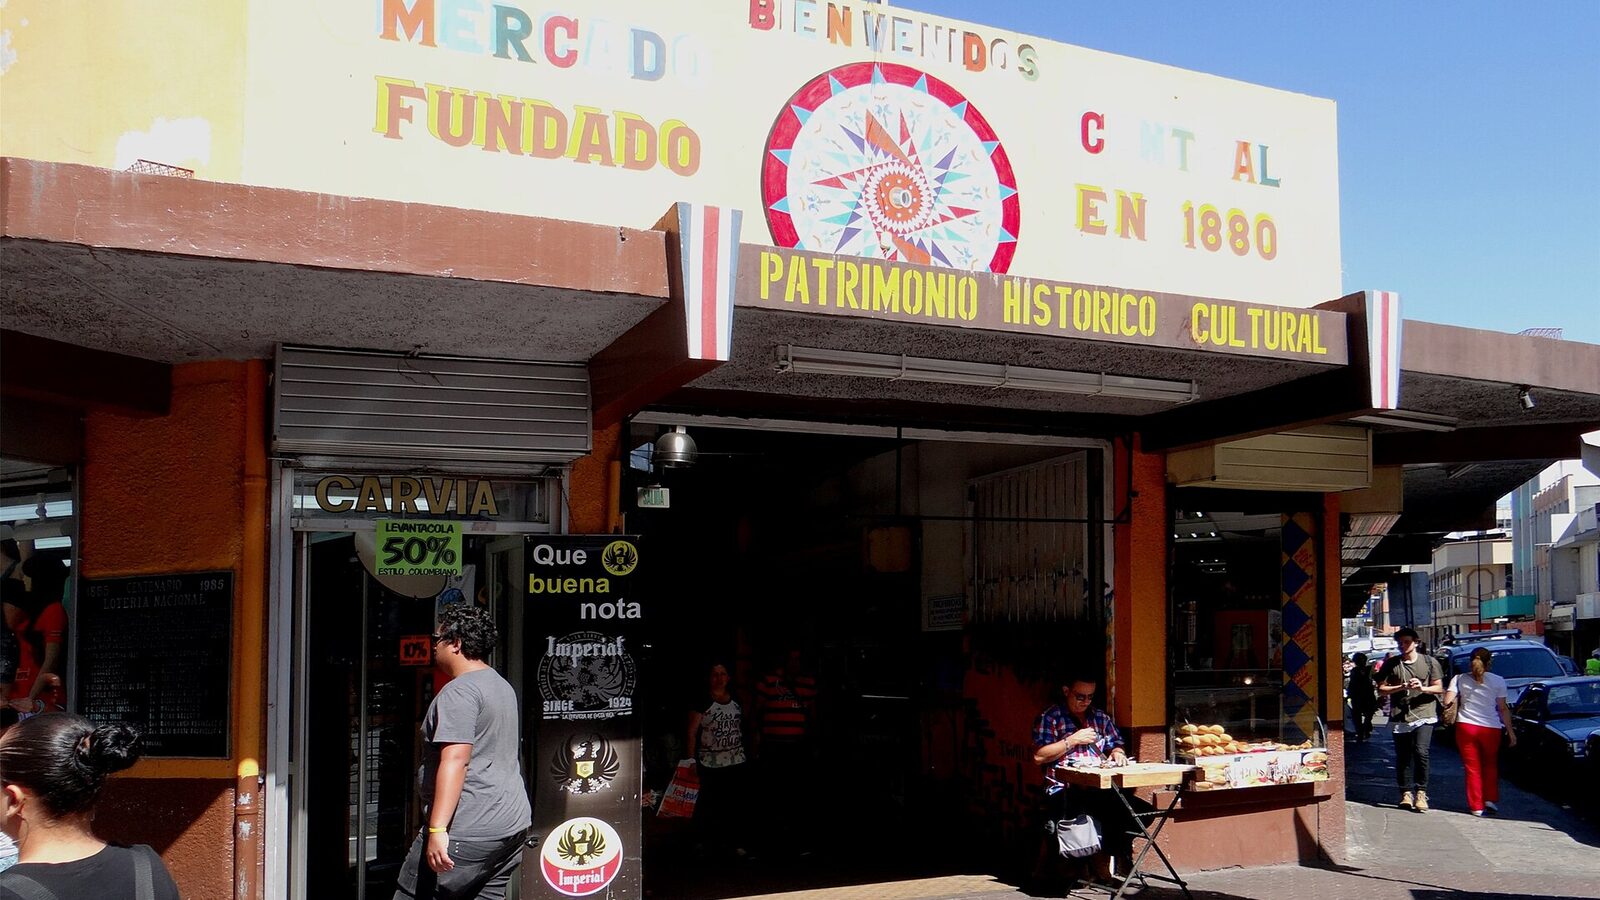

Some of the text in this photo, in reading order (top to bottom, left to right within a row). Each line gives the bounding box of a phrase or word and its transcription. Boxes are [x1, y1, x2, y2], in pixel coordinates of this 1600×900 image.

[374, 0, 709, 88] MERCADO
[749, 0, 1040, 82] BIENVENIDOS
[373, 75, 701, 177] FUNDADO
[1080, 109, 1282, 188] CNTAL
[1074, 183, 1278, 261] EN 1880
[760, 251, 1328, 355] PATRIMONIO HISTORICO CULTURAL
[315, 475, 499, 516] CARVIA
[385, 522, 454, 534] LEVANTACOLA
[382, 536, 457, 567] 50%
[533, 544, 588, 567] Que
[199, 578, 225, 592] 1985
[378, 567, 458, 577] ESTILO COLOMBIANO
[528, 573, 610, 594] buena
[103, 592, 206, 610] LOTERIA NACIONAL
[580, 597, 642, 620] nota
[546, 635, 626, 668] Imperial
[542, 697, 632, 712] SINCE 1924
[558, 865, 604, 893] Imperial
